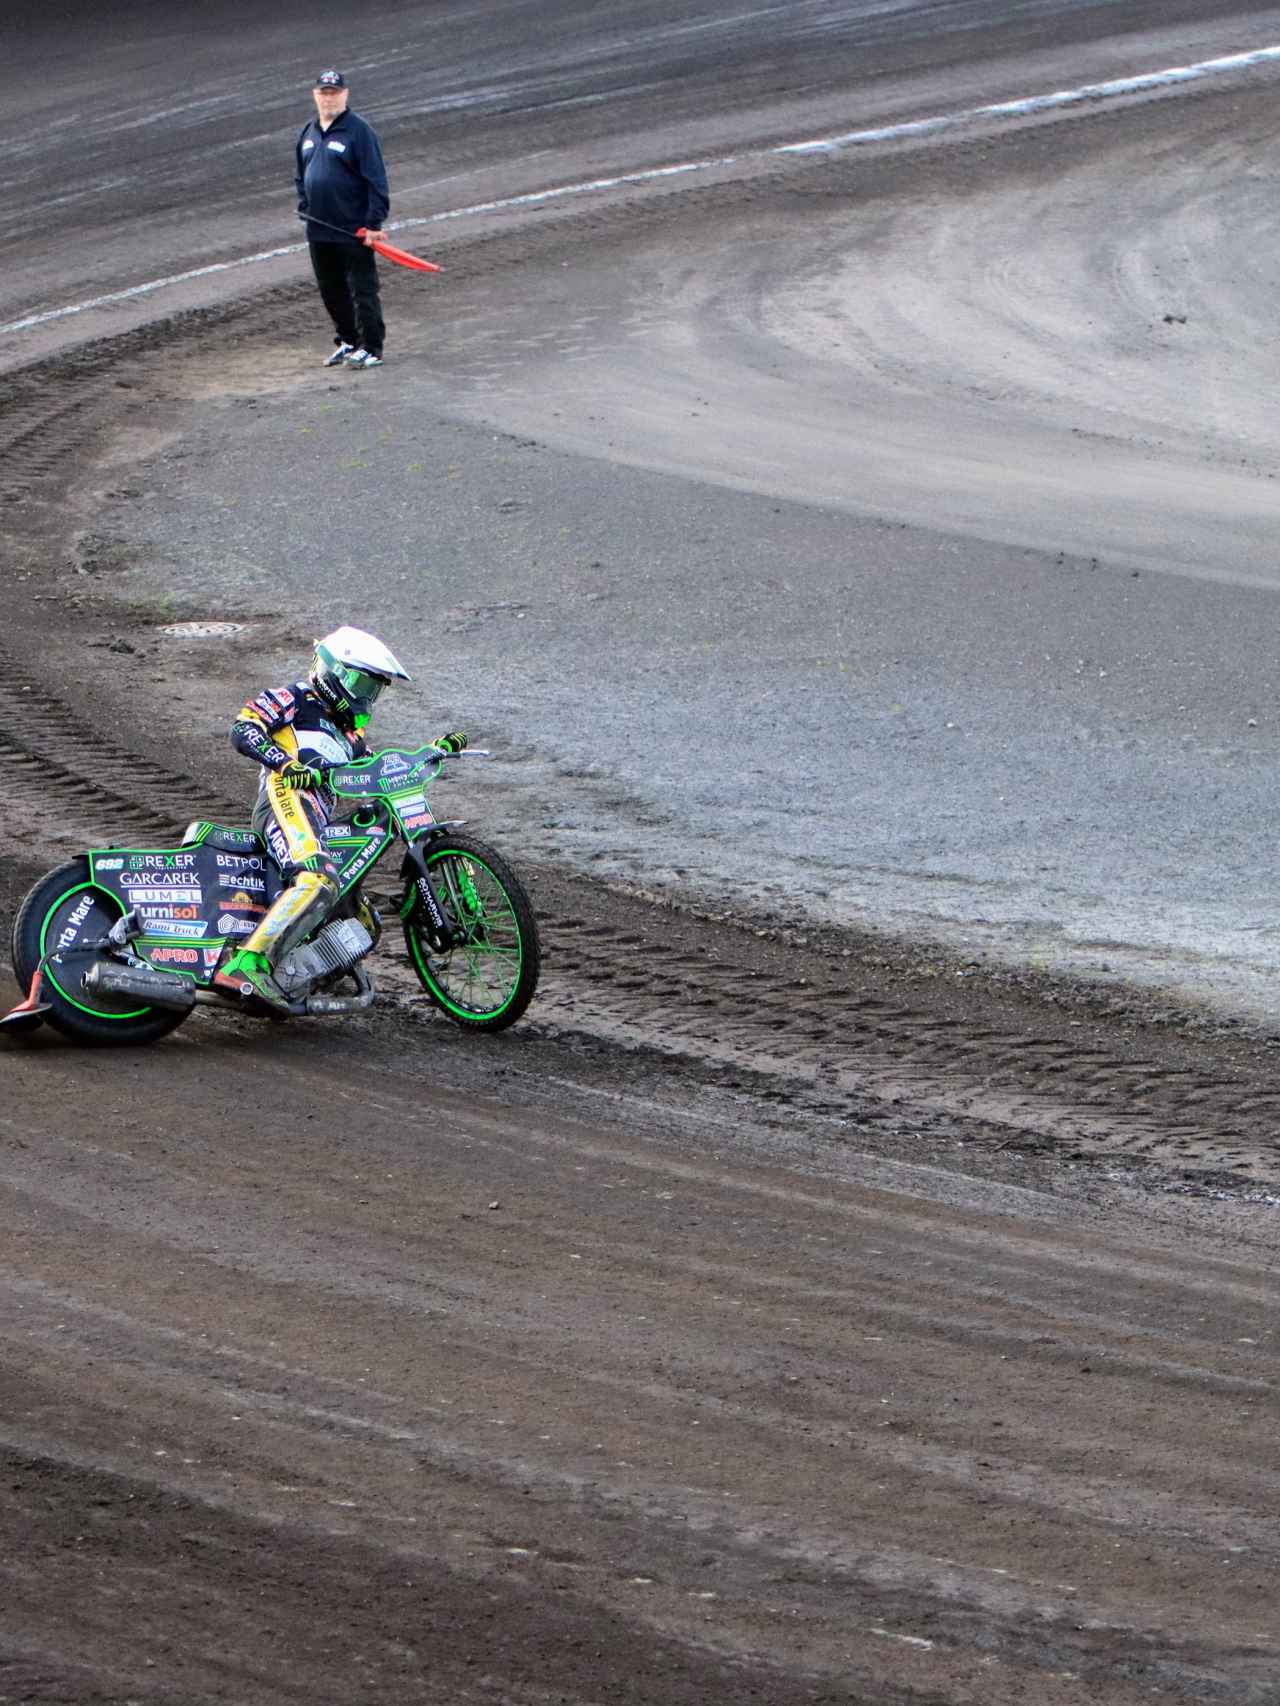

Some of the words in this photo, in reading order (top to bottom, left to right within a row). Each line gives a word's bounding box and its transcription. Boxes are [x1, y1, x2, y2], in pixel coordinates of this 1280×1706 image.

[244, 729, 285, 763] REXER
[342, 775, 371, 784] REXER
[223, 832, 257, 843] REXER
[95, 858, 124, 870] 692
[145, 854, 195, 868] REXER
[216, 854, 267, 871] BETPOL
[344, 858, 364, 880] Porta
[363, 838, 381, 863] Mare
[120, 871, 201, 885] GARCAREK
[67, 895, 95, 926] Mare
[150, 948, 199, 963] APRO
